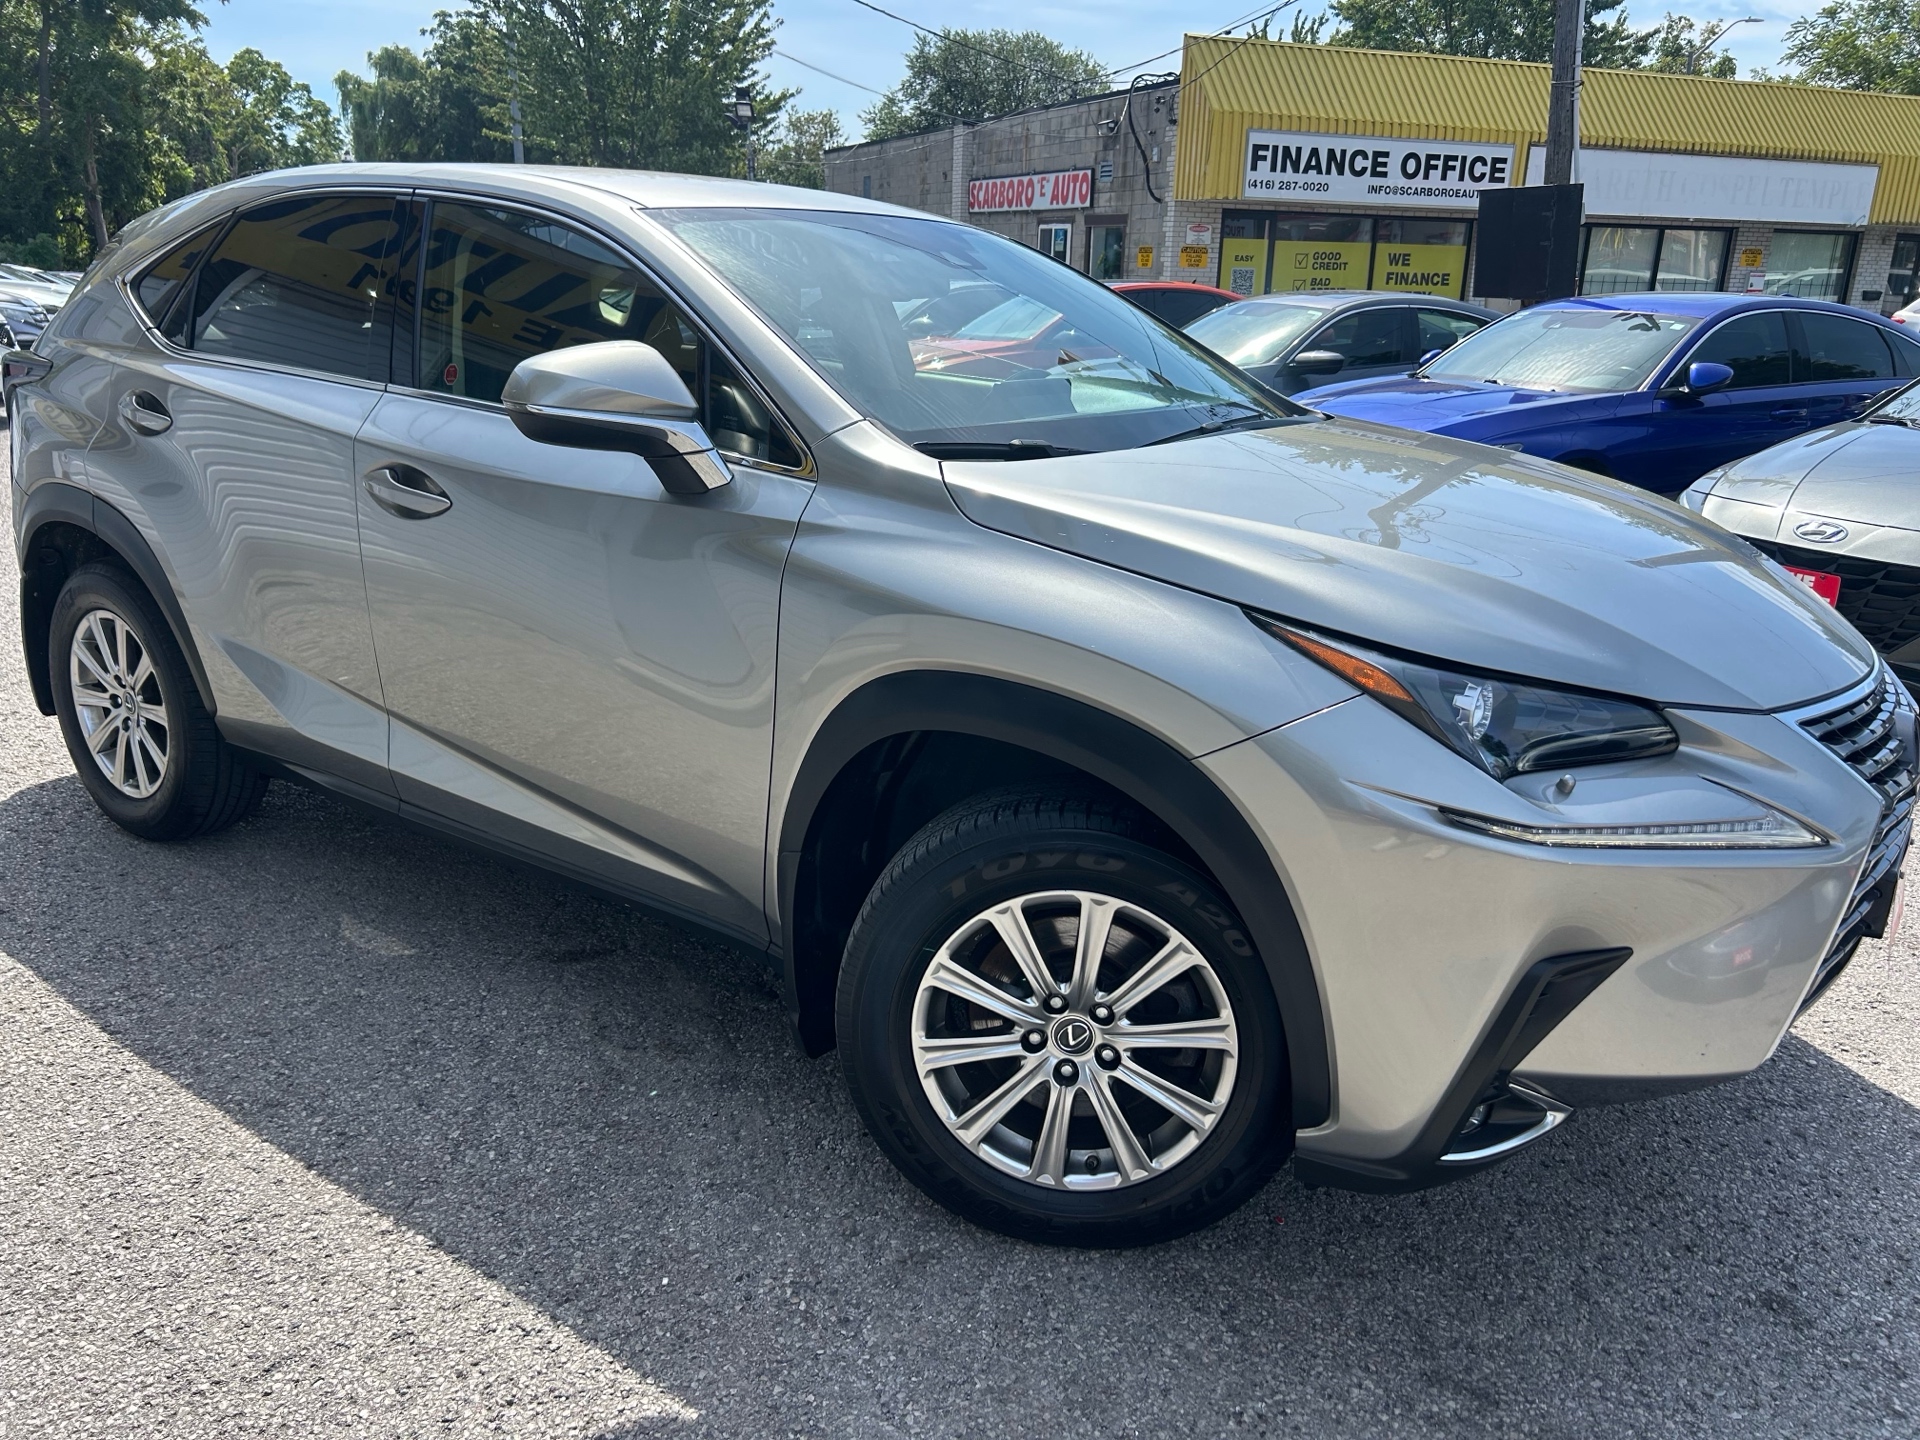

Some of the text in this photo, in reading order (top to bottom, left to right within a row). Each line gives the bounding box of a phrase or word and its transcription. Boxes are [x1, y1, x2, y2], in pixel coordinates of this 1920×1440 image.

[1250, 143, 1508, 183] FINANCE OFFICE
[970, 177, 1035, 210] SCARBORO
[1050, 171, 1090, 206] AUTO
[1248, 179, 1329, 192] (416) 287-0020
[1234, 254, 1254, 262] EASY
[1313, 251, 1342, 261] GOOD
[1388, 252, 1411, 267] WE
[1312, 261, 1349, 271] CREDIT
[1310, 277, 1331, 287] BAD
[1385, 271, 1451, 287] FINANCE
[938, 849, 1126, 900] TOYO
